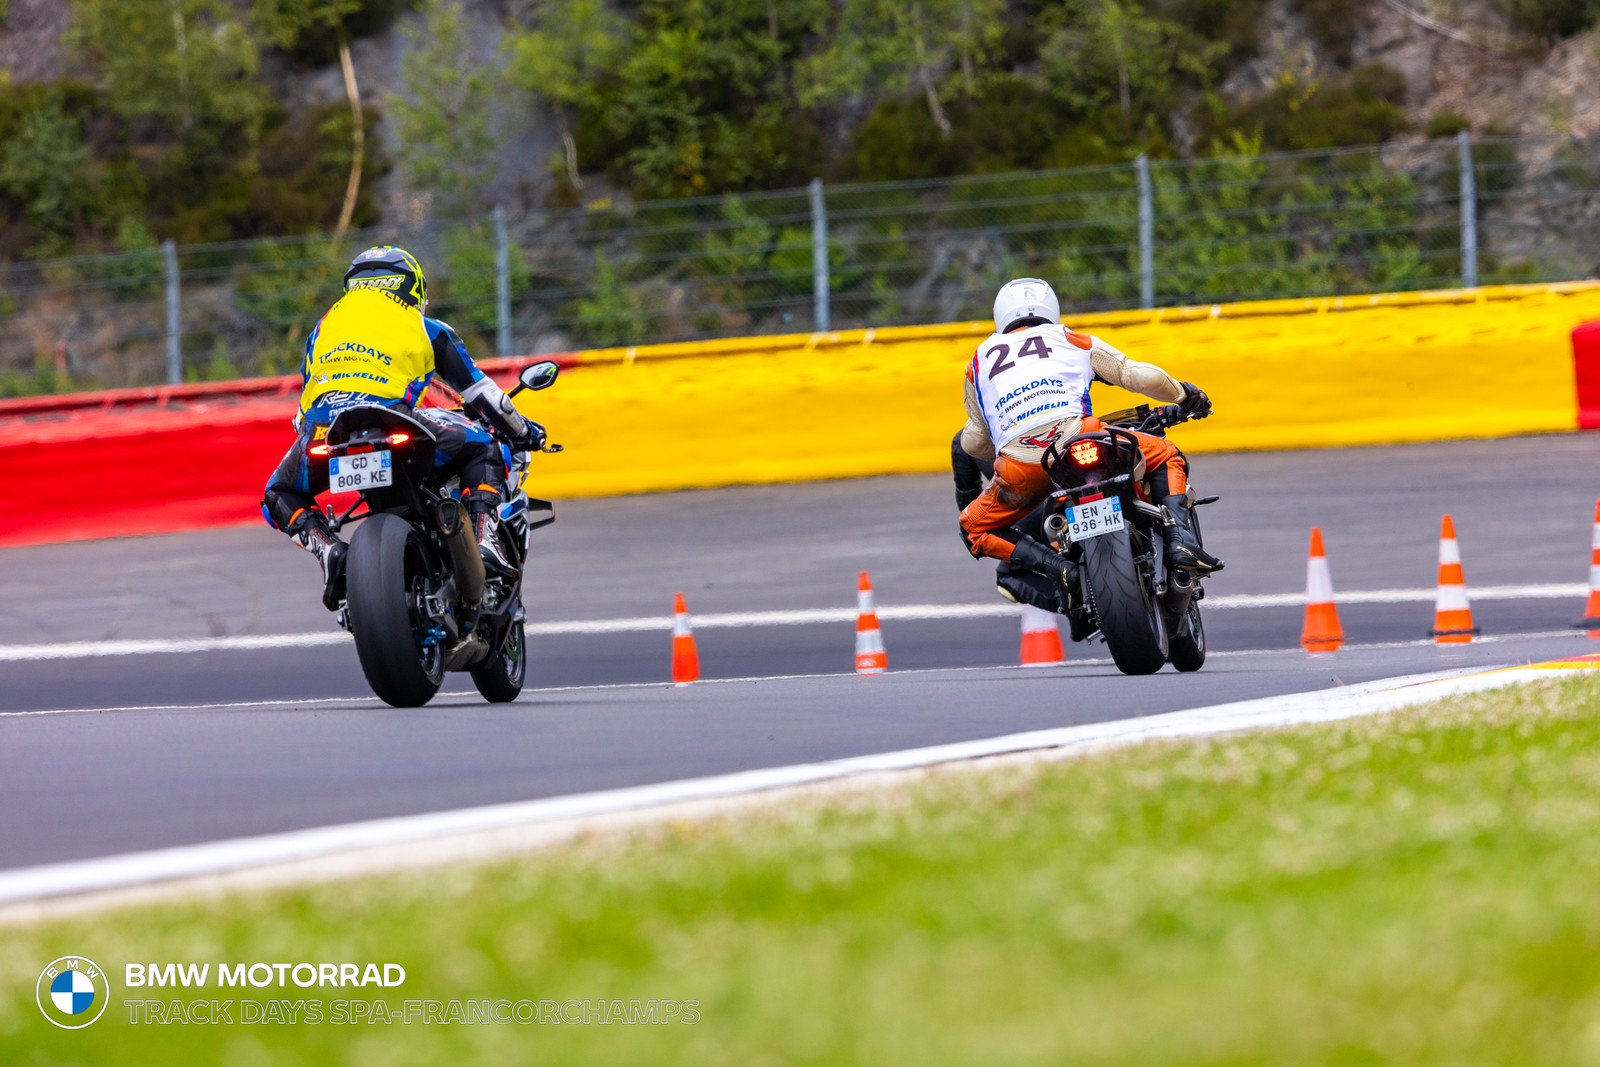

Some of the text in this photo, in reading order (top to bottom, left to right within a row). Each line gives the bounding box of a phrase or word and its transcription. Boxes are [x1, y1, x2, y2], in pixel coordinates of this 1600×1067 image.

[985, 335, 1053, 381] 24
[332, 372, 389, 384] MICHELIN
[995, 378, 1064, 411] TRACKDAYS
[1004, 400, 1022, 413] BMW
[1016, 401, 1069, 422] MICHELIN
